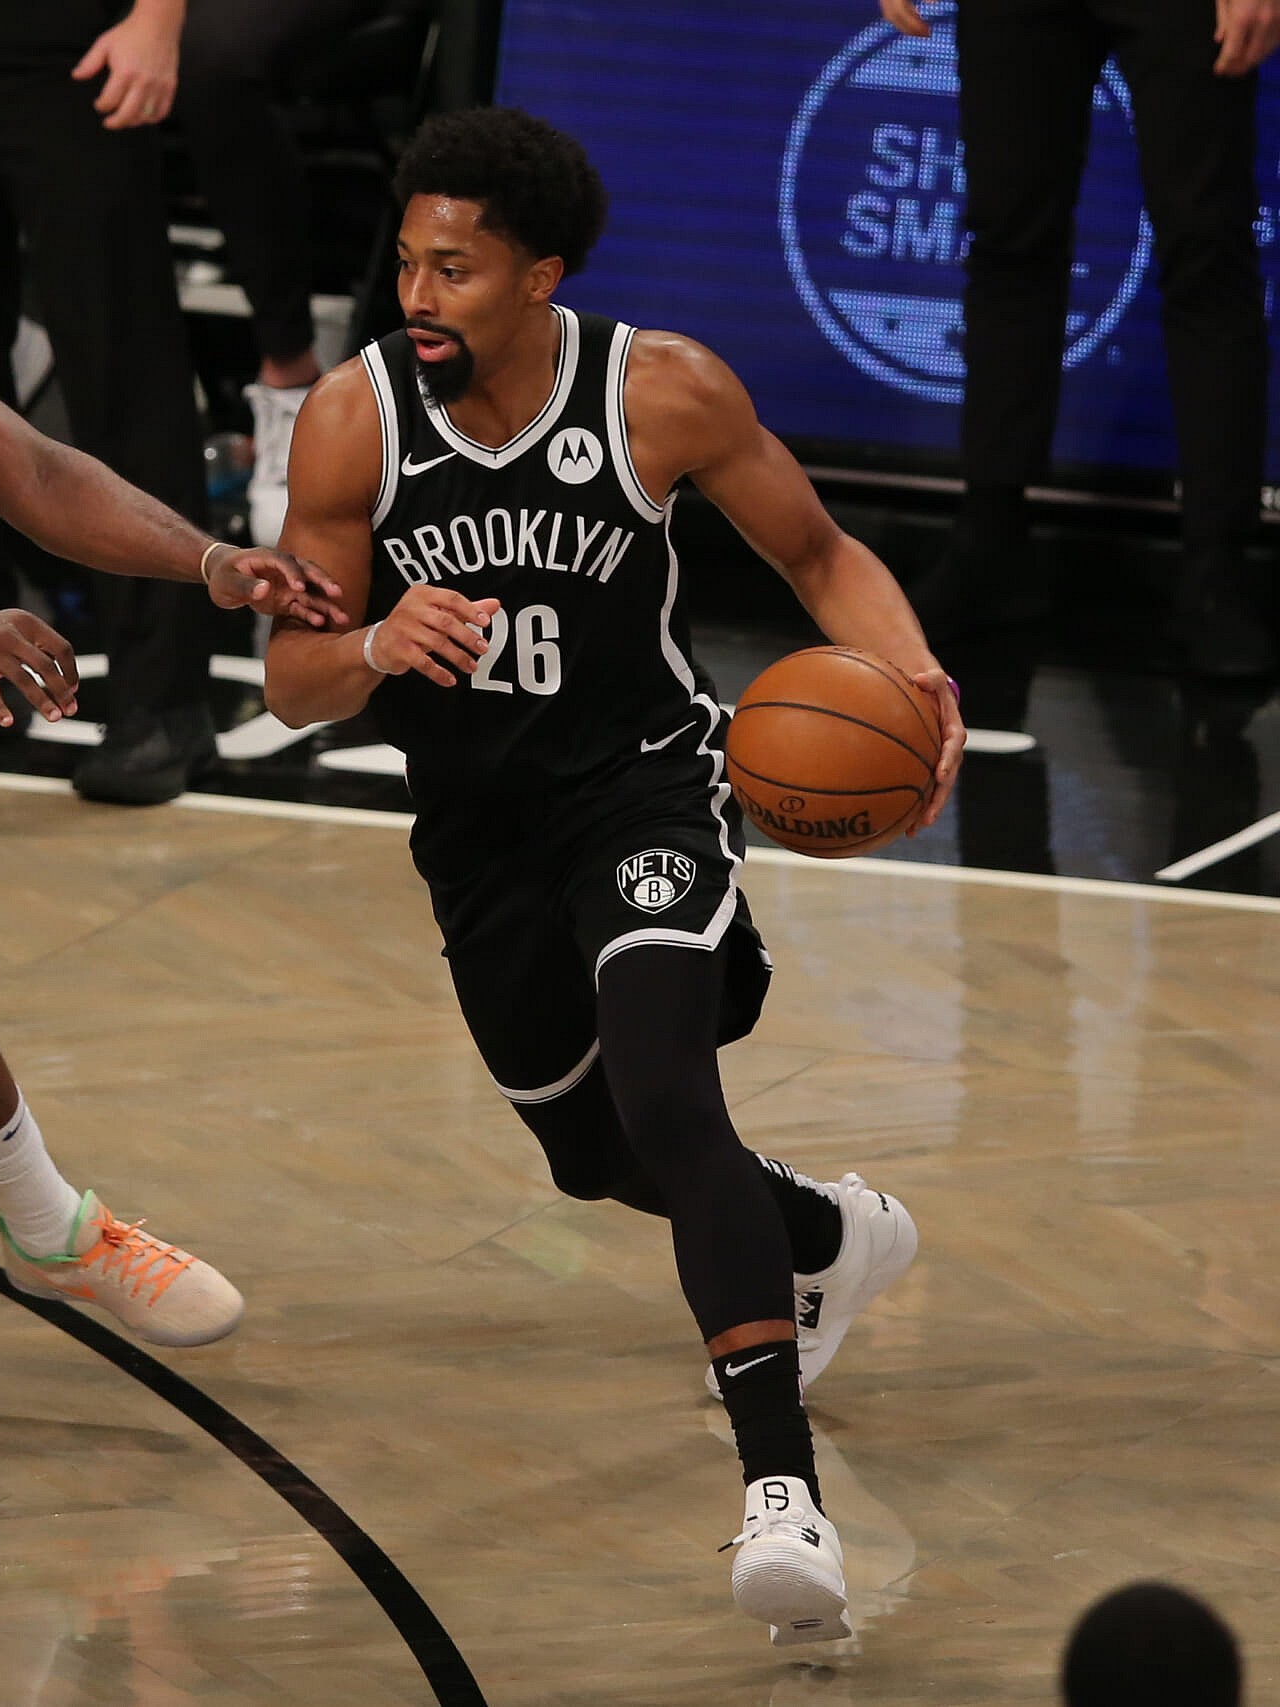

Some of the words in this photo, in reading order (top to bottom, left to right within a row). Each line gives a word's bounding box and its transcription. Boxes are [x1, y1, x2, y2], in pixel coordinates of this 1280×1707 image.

[840, 191, 974, 263] SM
[383, 508, 635, 587] BROOKLYN
[466, 604, 562, 696] 26
[622, 852, 691, 889] NETS
[648, 881, 661, 903] B
